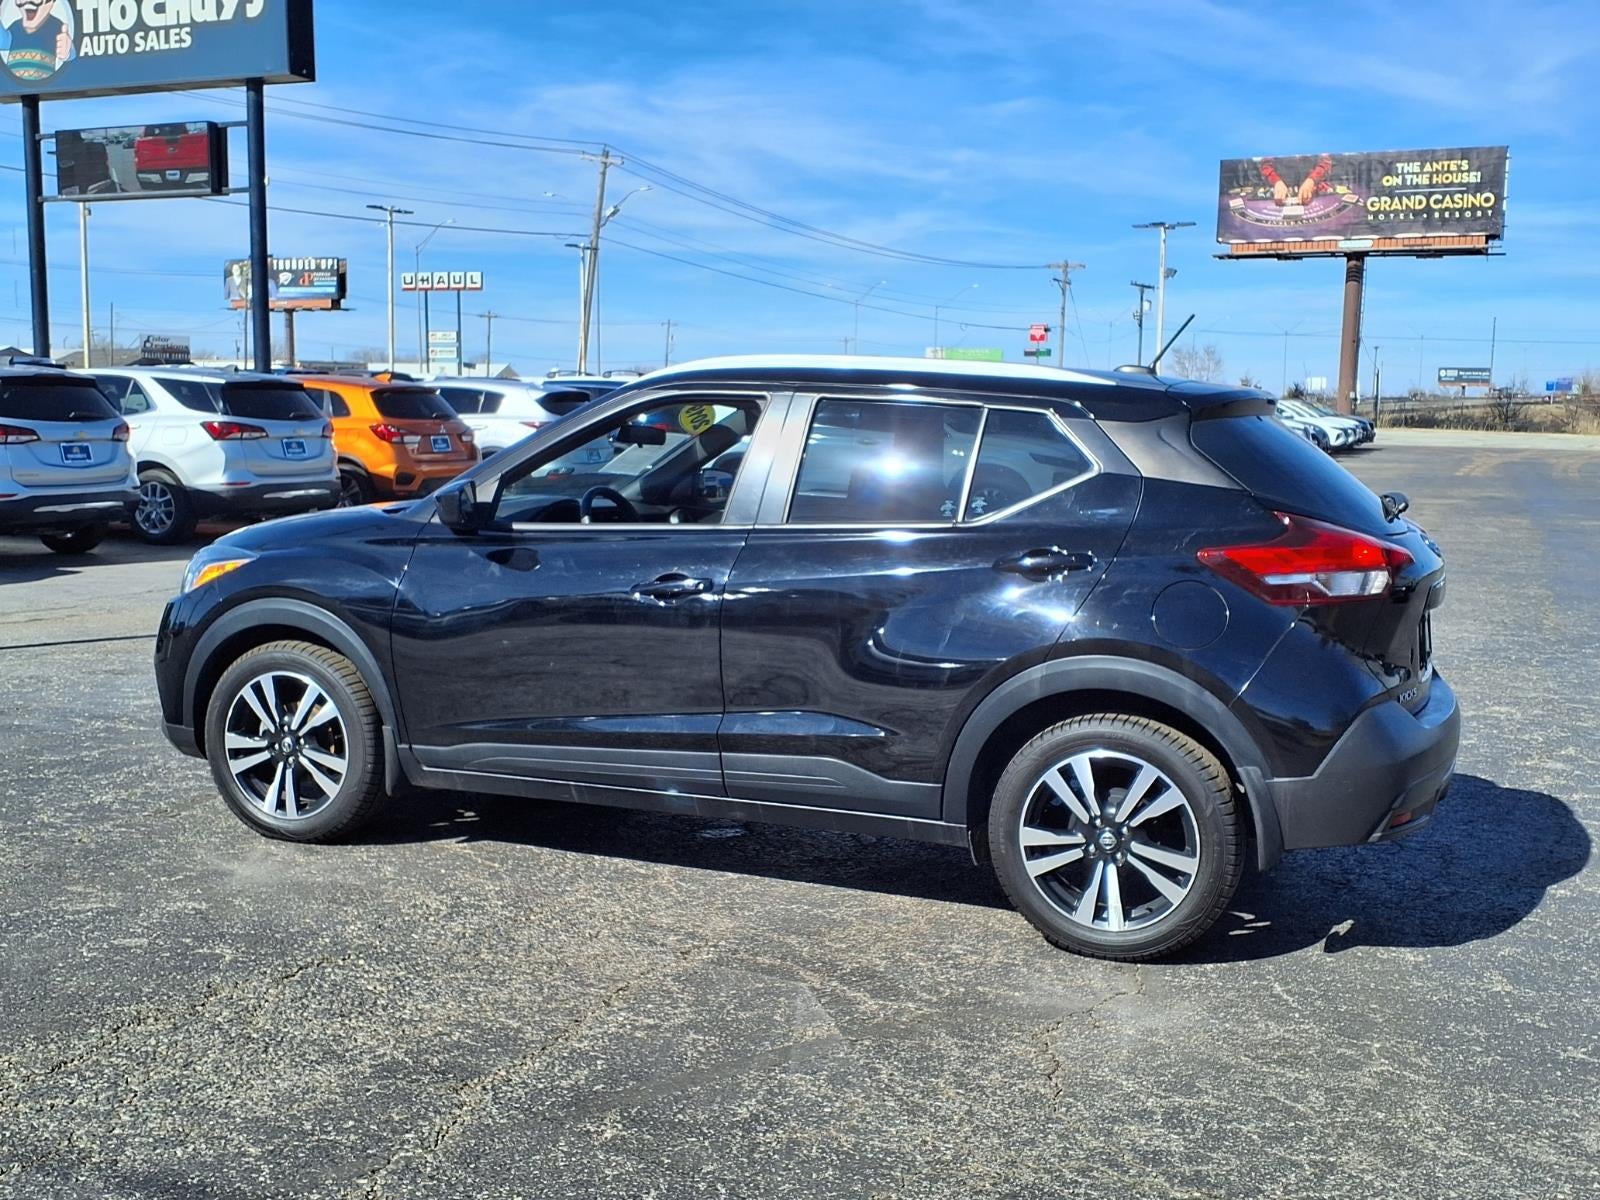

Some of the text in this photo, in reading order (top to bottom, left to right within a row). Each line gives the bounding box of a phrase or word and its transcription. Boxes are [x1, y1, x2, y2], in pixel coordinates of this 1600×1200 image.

[79, 26, 192, 57] AUTO SALES
[1396, 159, 1469, 174] THE ANTE'S
[1382, 171, 1482, 187] ON THE HOUSE!
[1366, 191, 1496, 212] GRAND CASINO
[1434, 210, 1493, 219] RESORT
